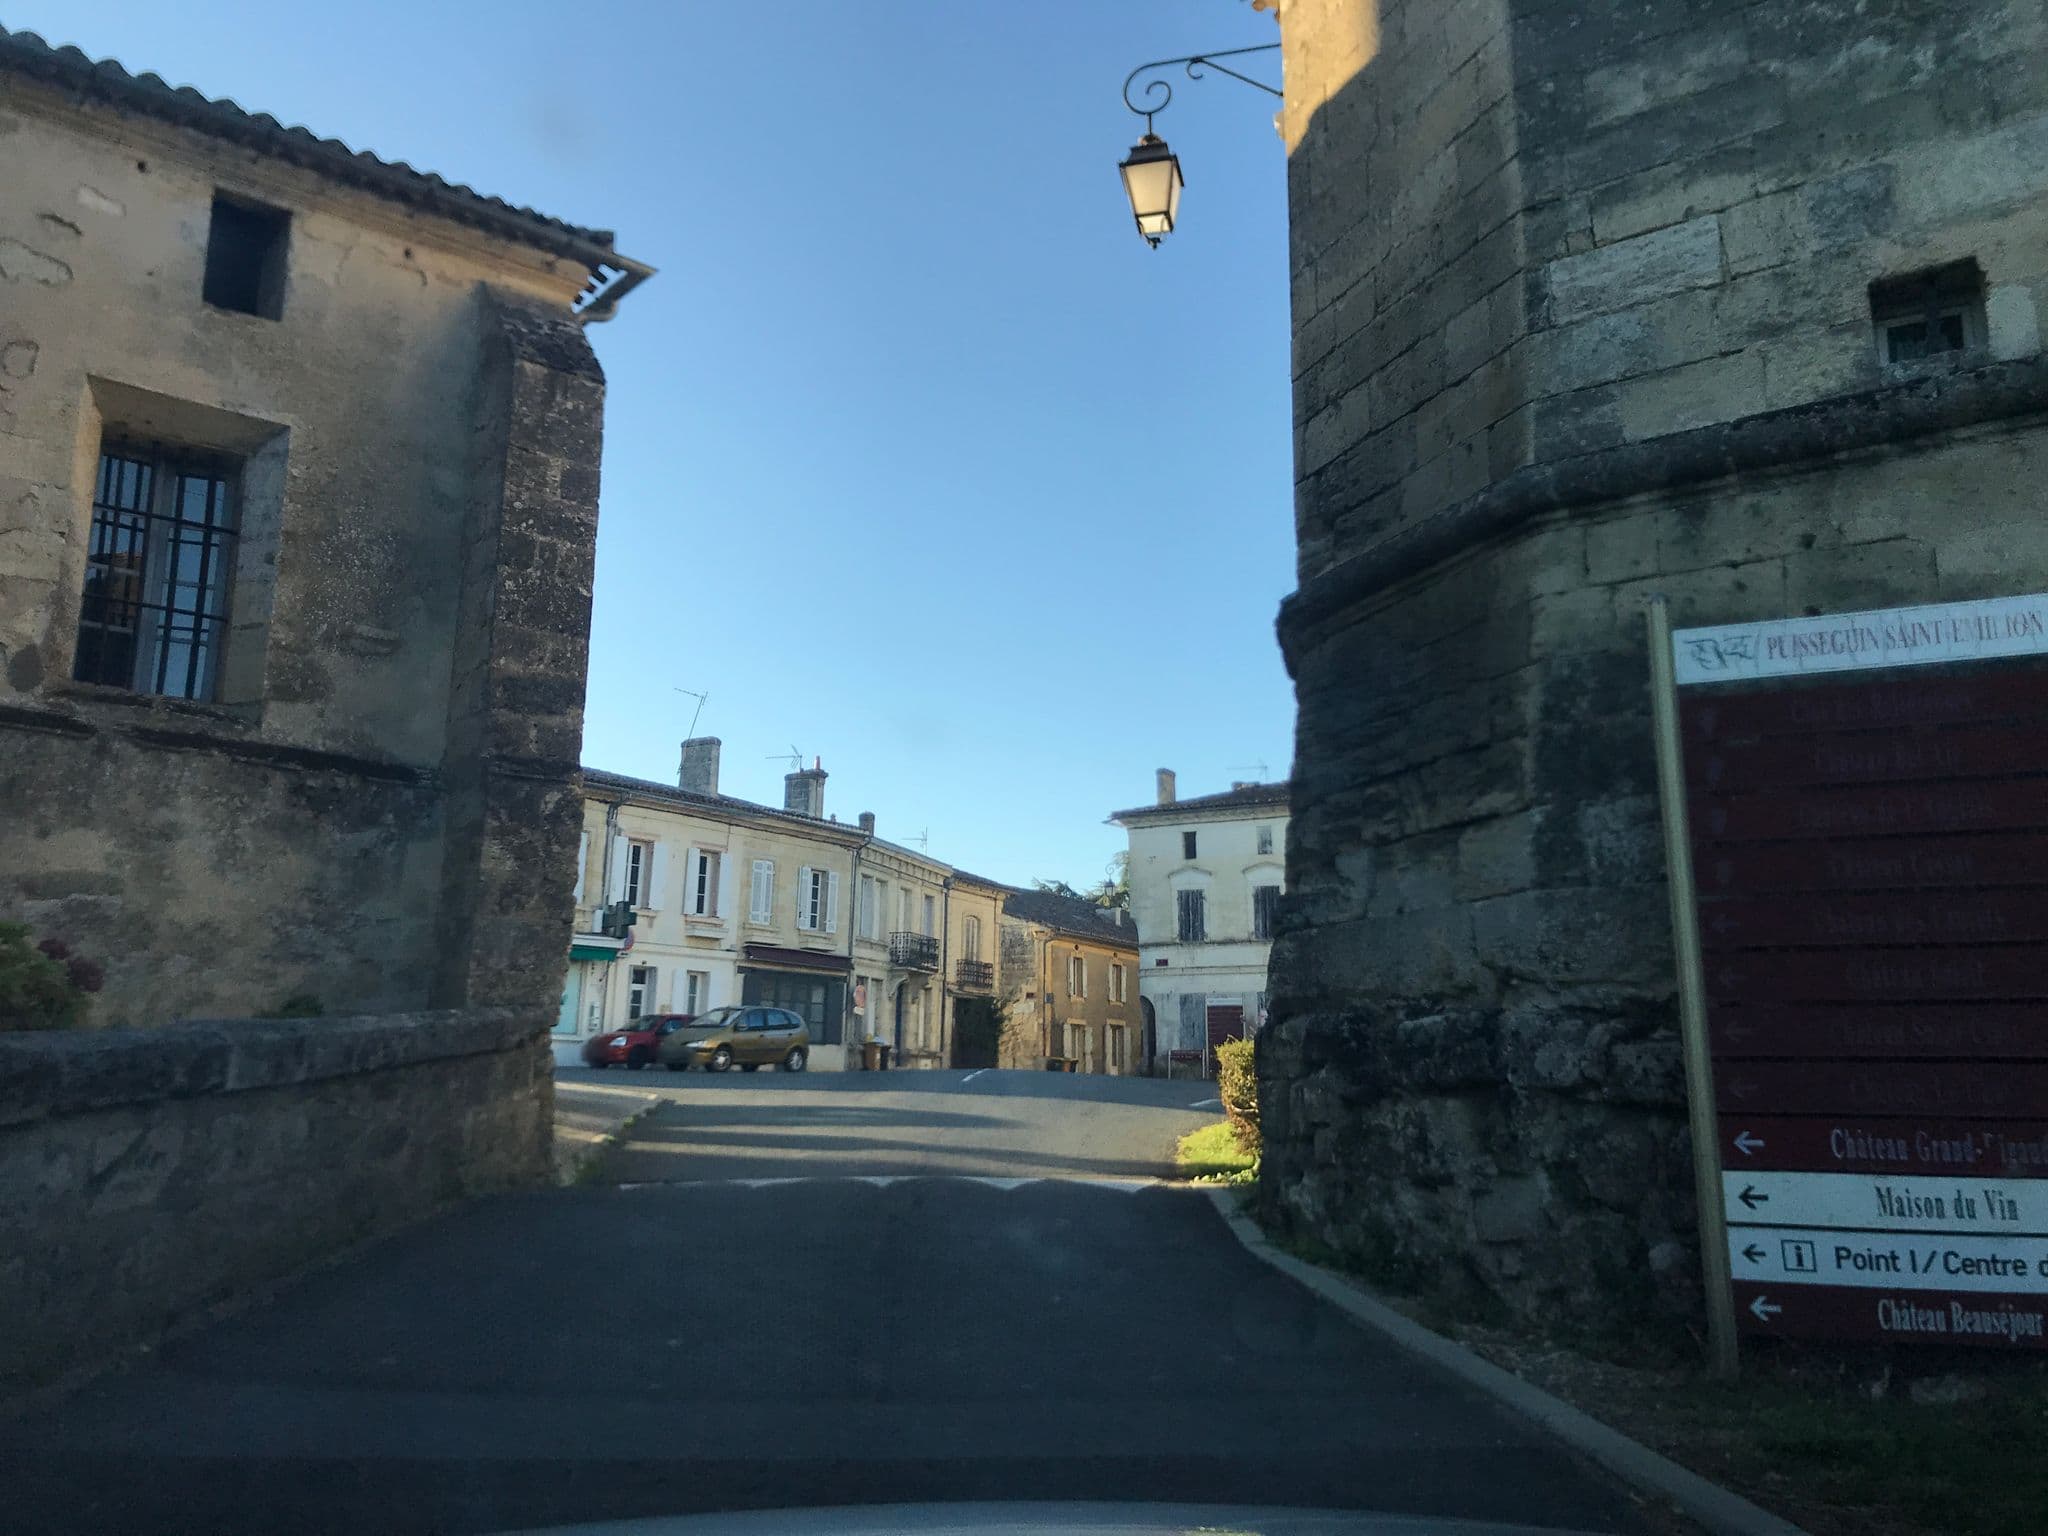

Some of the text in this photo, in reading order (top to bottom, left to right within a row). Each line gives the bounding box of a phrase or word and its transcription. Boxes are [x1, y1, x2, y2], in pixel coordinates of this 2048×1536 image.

[1767, 628, 1879, 659] PUISSEGUIN
[1885, 620, 1942, 648] SAINT
[1831, 1128, 1908, 1161] Château
[1875, 1187, 2018, 1221] Maison du Vin
[1834, 1246, 1900, 1273] Point
[1878, 1299, 1946, 1333] Château
